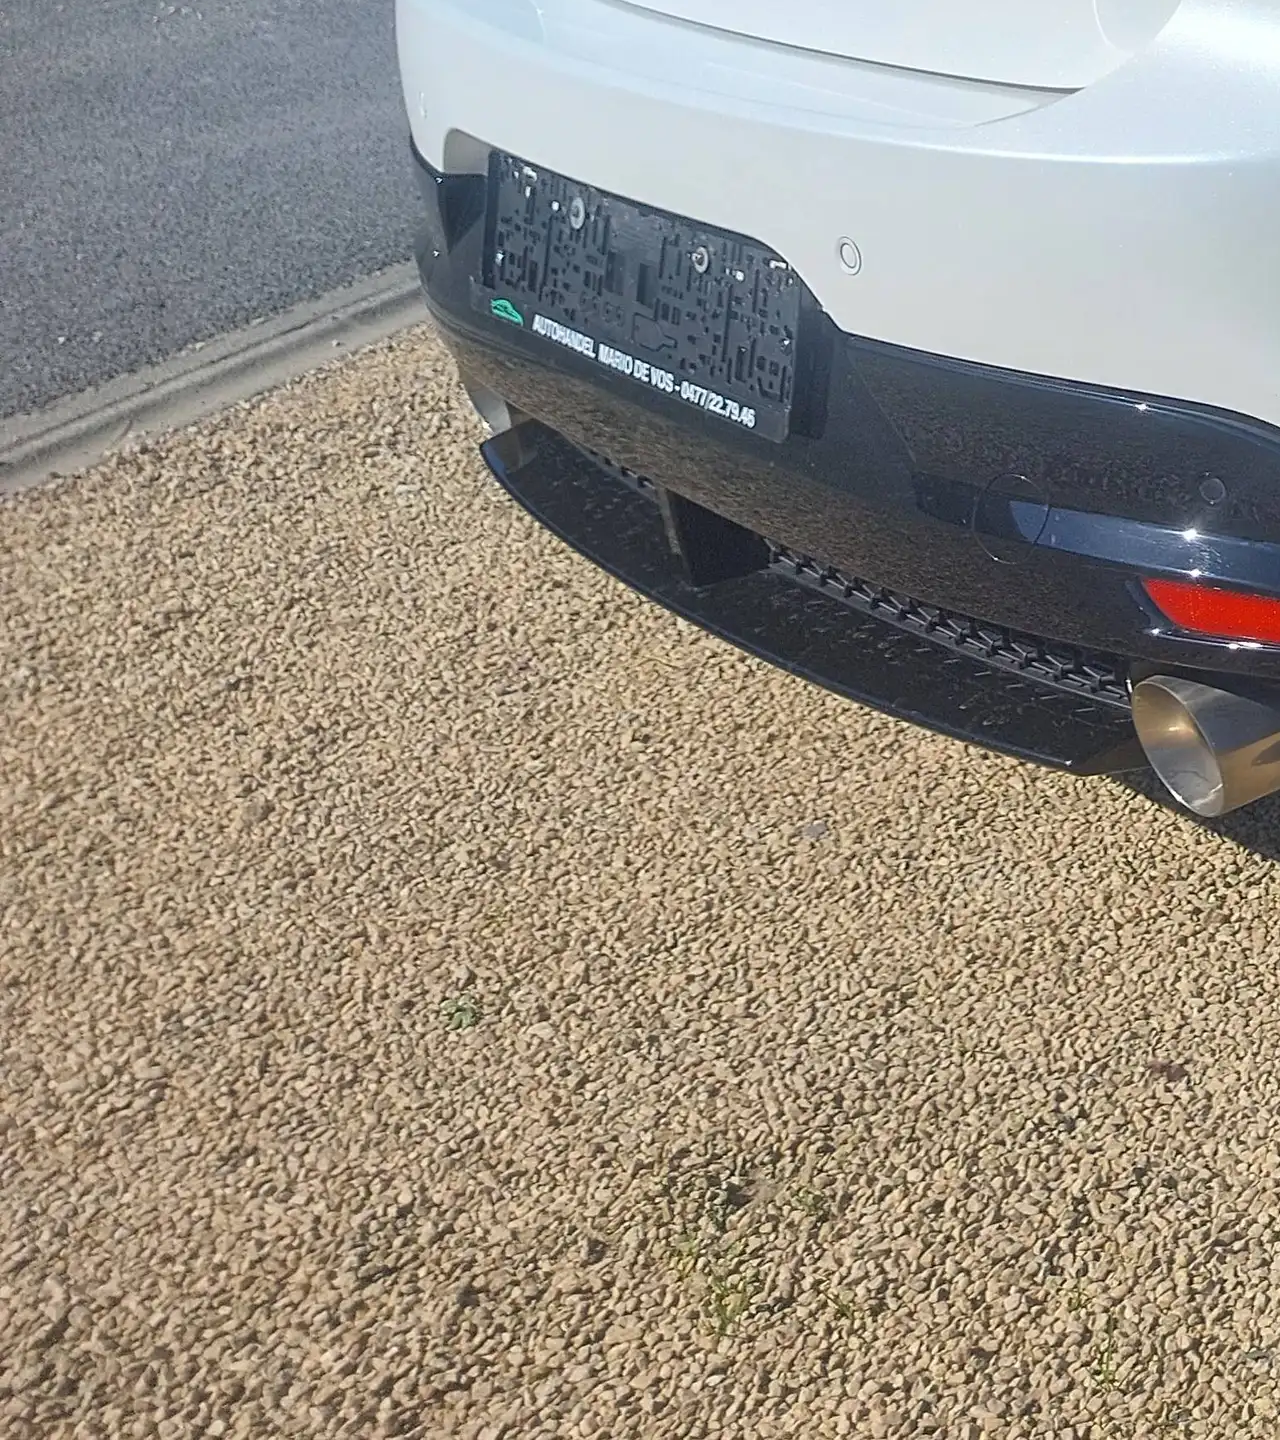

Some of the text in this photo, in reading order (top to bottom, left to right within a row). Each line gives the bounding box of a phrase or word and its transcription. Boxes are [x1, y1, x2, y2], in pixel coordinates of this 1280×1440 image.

[532, 313, 596, 359] AUTOHANDEL
[598, 342, 634, 376] MARIO
[633, 359, 651, 383] DE
[649, 365, 674, 393] VOS
